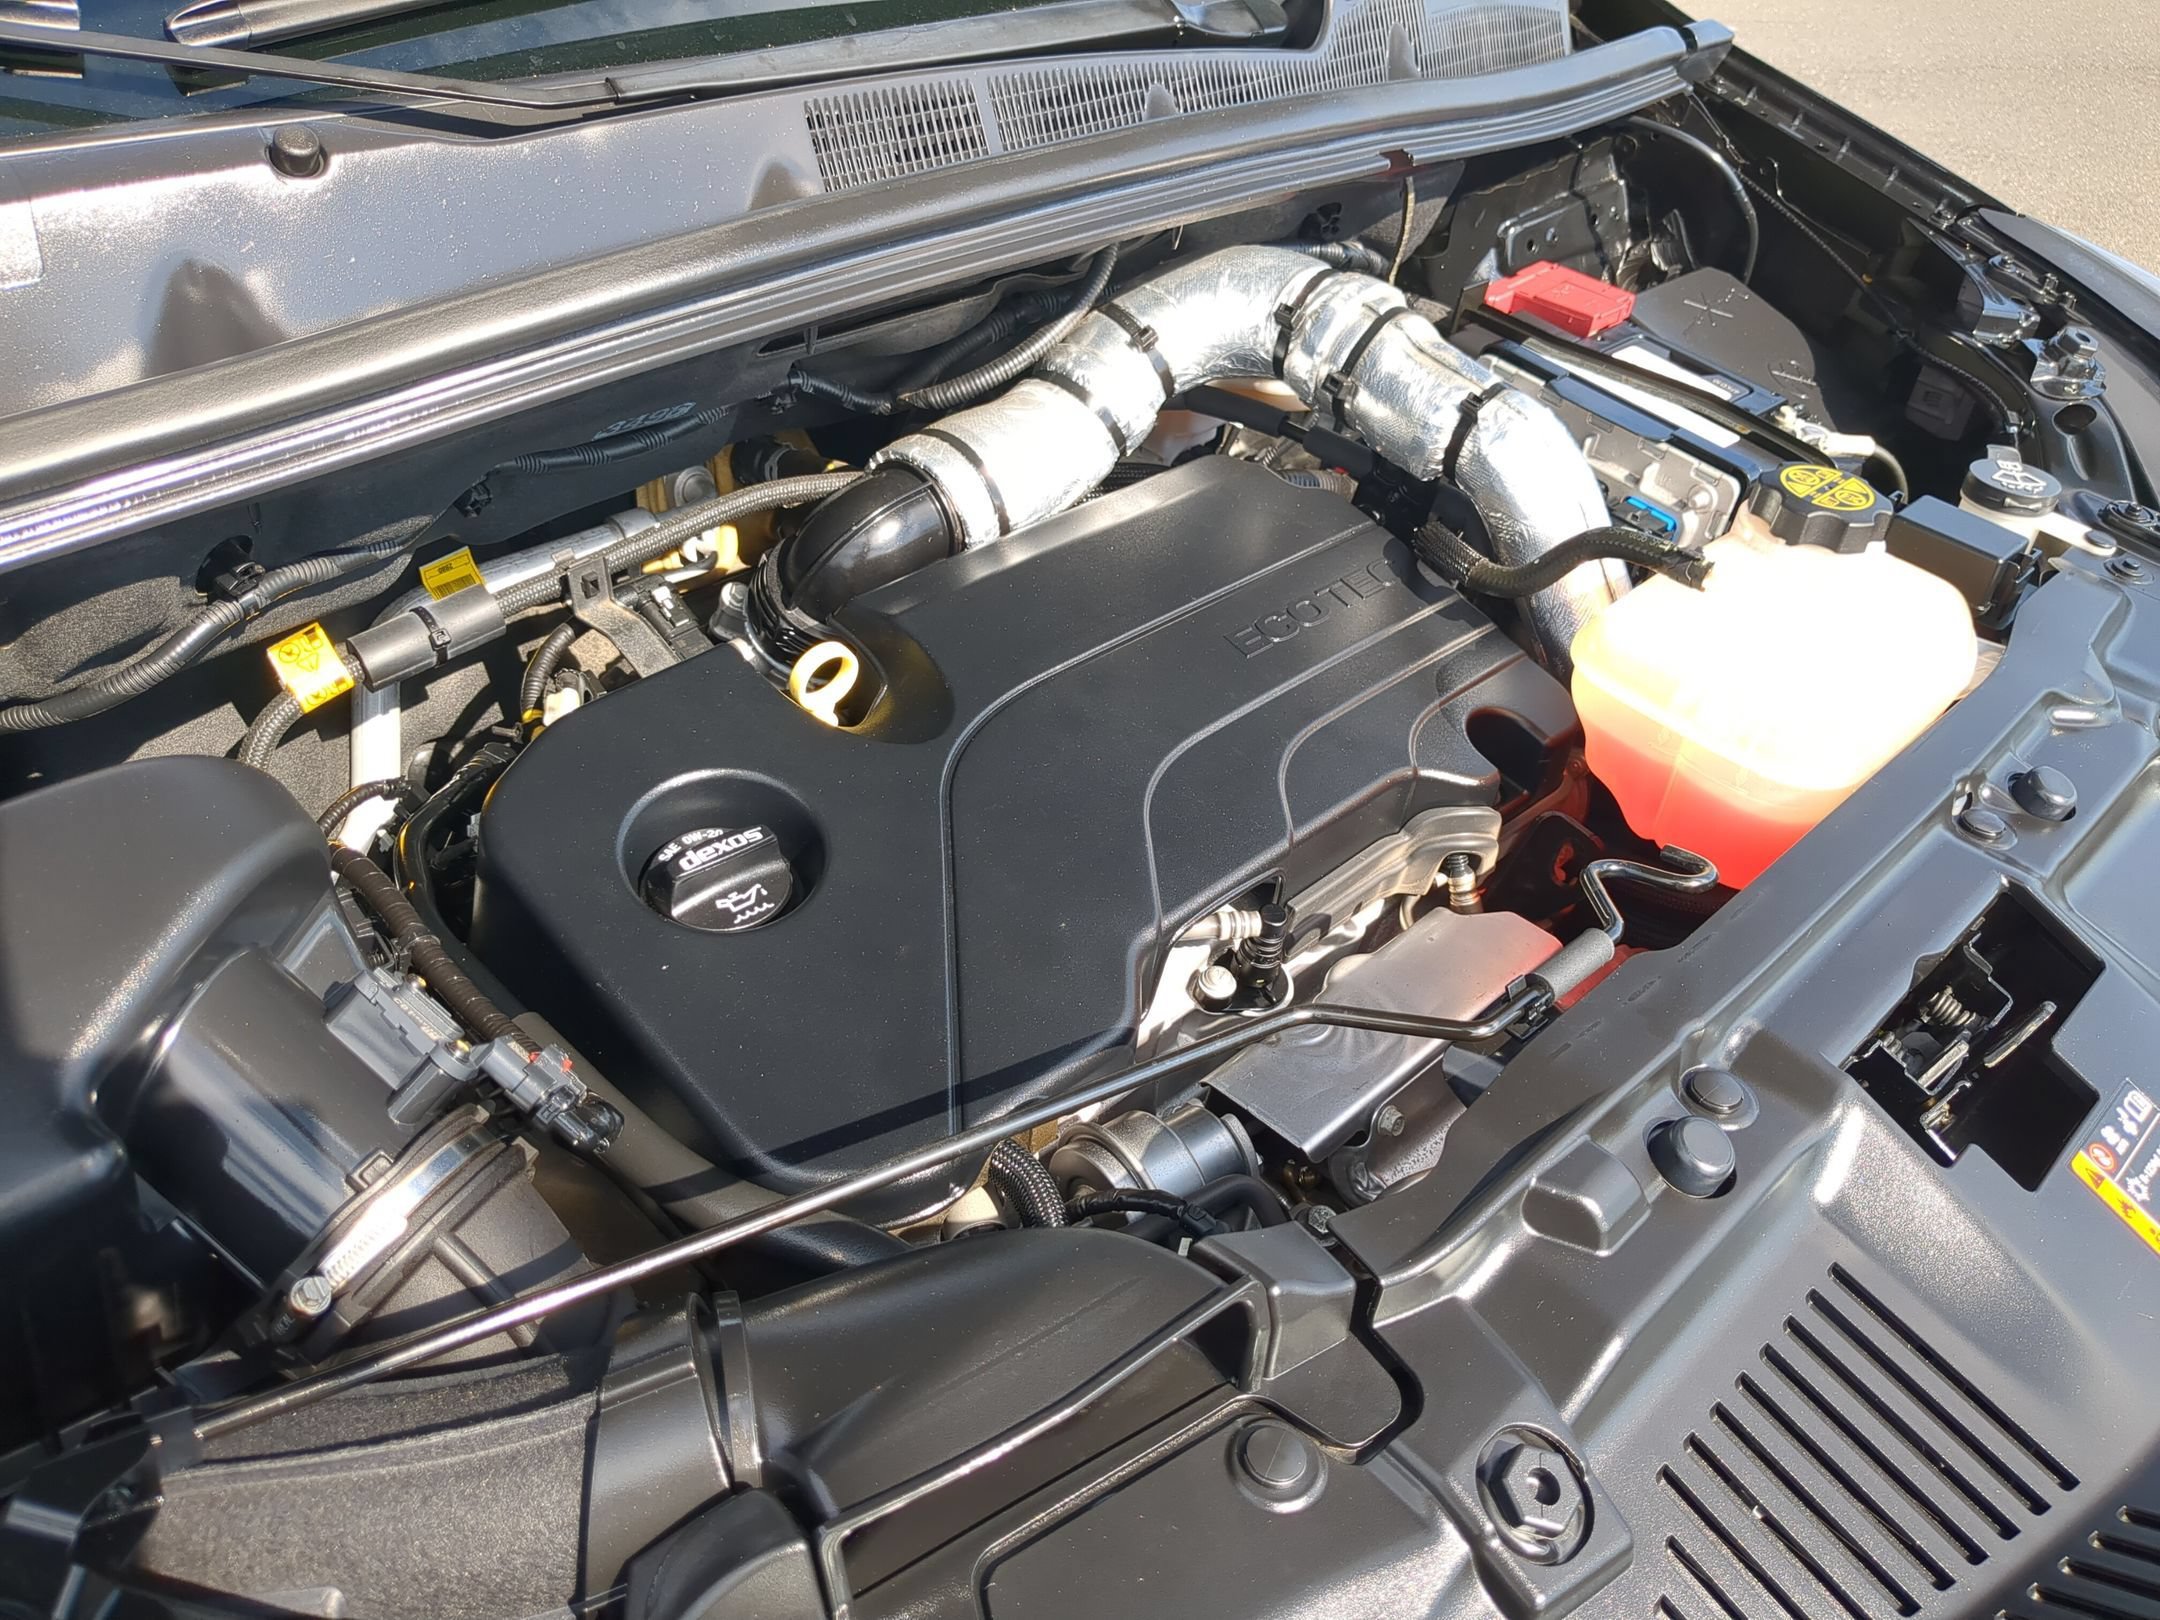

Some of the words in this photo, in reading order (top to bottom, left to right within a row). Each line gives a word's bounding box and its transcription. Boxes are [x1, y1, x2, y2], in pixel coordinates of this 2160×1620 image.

[1222, 558, 1396, 660] ECOTEC
[658, 842, 682, 862] SAE
[678, 826, 763, 871] dexos
